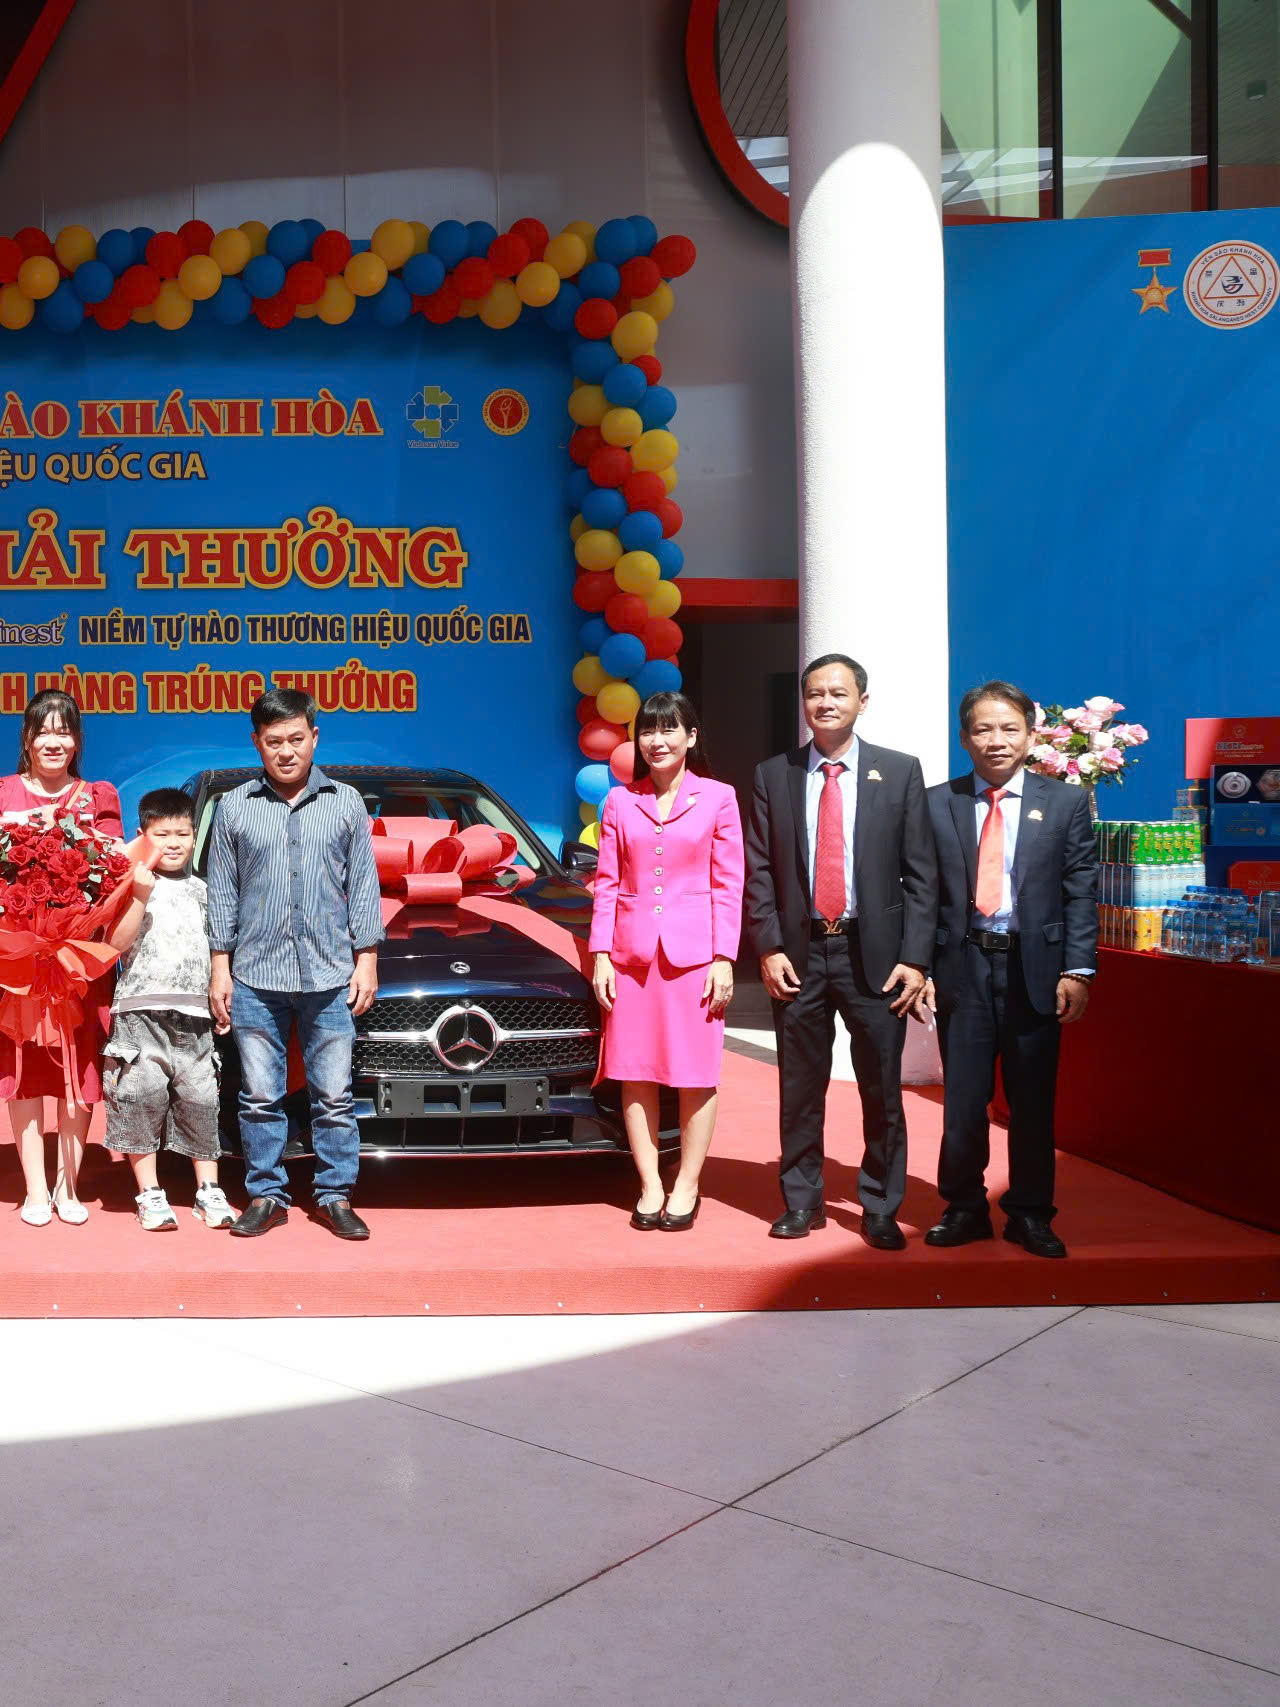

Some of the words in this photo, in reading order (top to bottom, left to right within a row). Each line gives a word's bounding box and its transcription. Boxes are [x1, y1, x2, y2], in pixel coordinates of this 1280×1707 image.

[79, 388, 264, 438] KHÁNH
[272, 388, 384, 437] HÒA
[44, 444, 141, 485] QUỐC
[148, 450, 208, 480] GIA
[123, 506, 468, 590] THƯỞNG
[79, 608, 146, 646] NIỀM
[152, 613, 186, 650] TỰ
[190, 609, 241, 644] HÀO
[245, 613, 345, 644] THƯƠNG
[351, 613, 408, 649] HIỆU
[415, 605, 483, 646] QUỐC
[488, 613, 532, 644] GIA
[143, 664, 265, 714] TRÚNG
